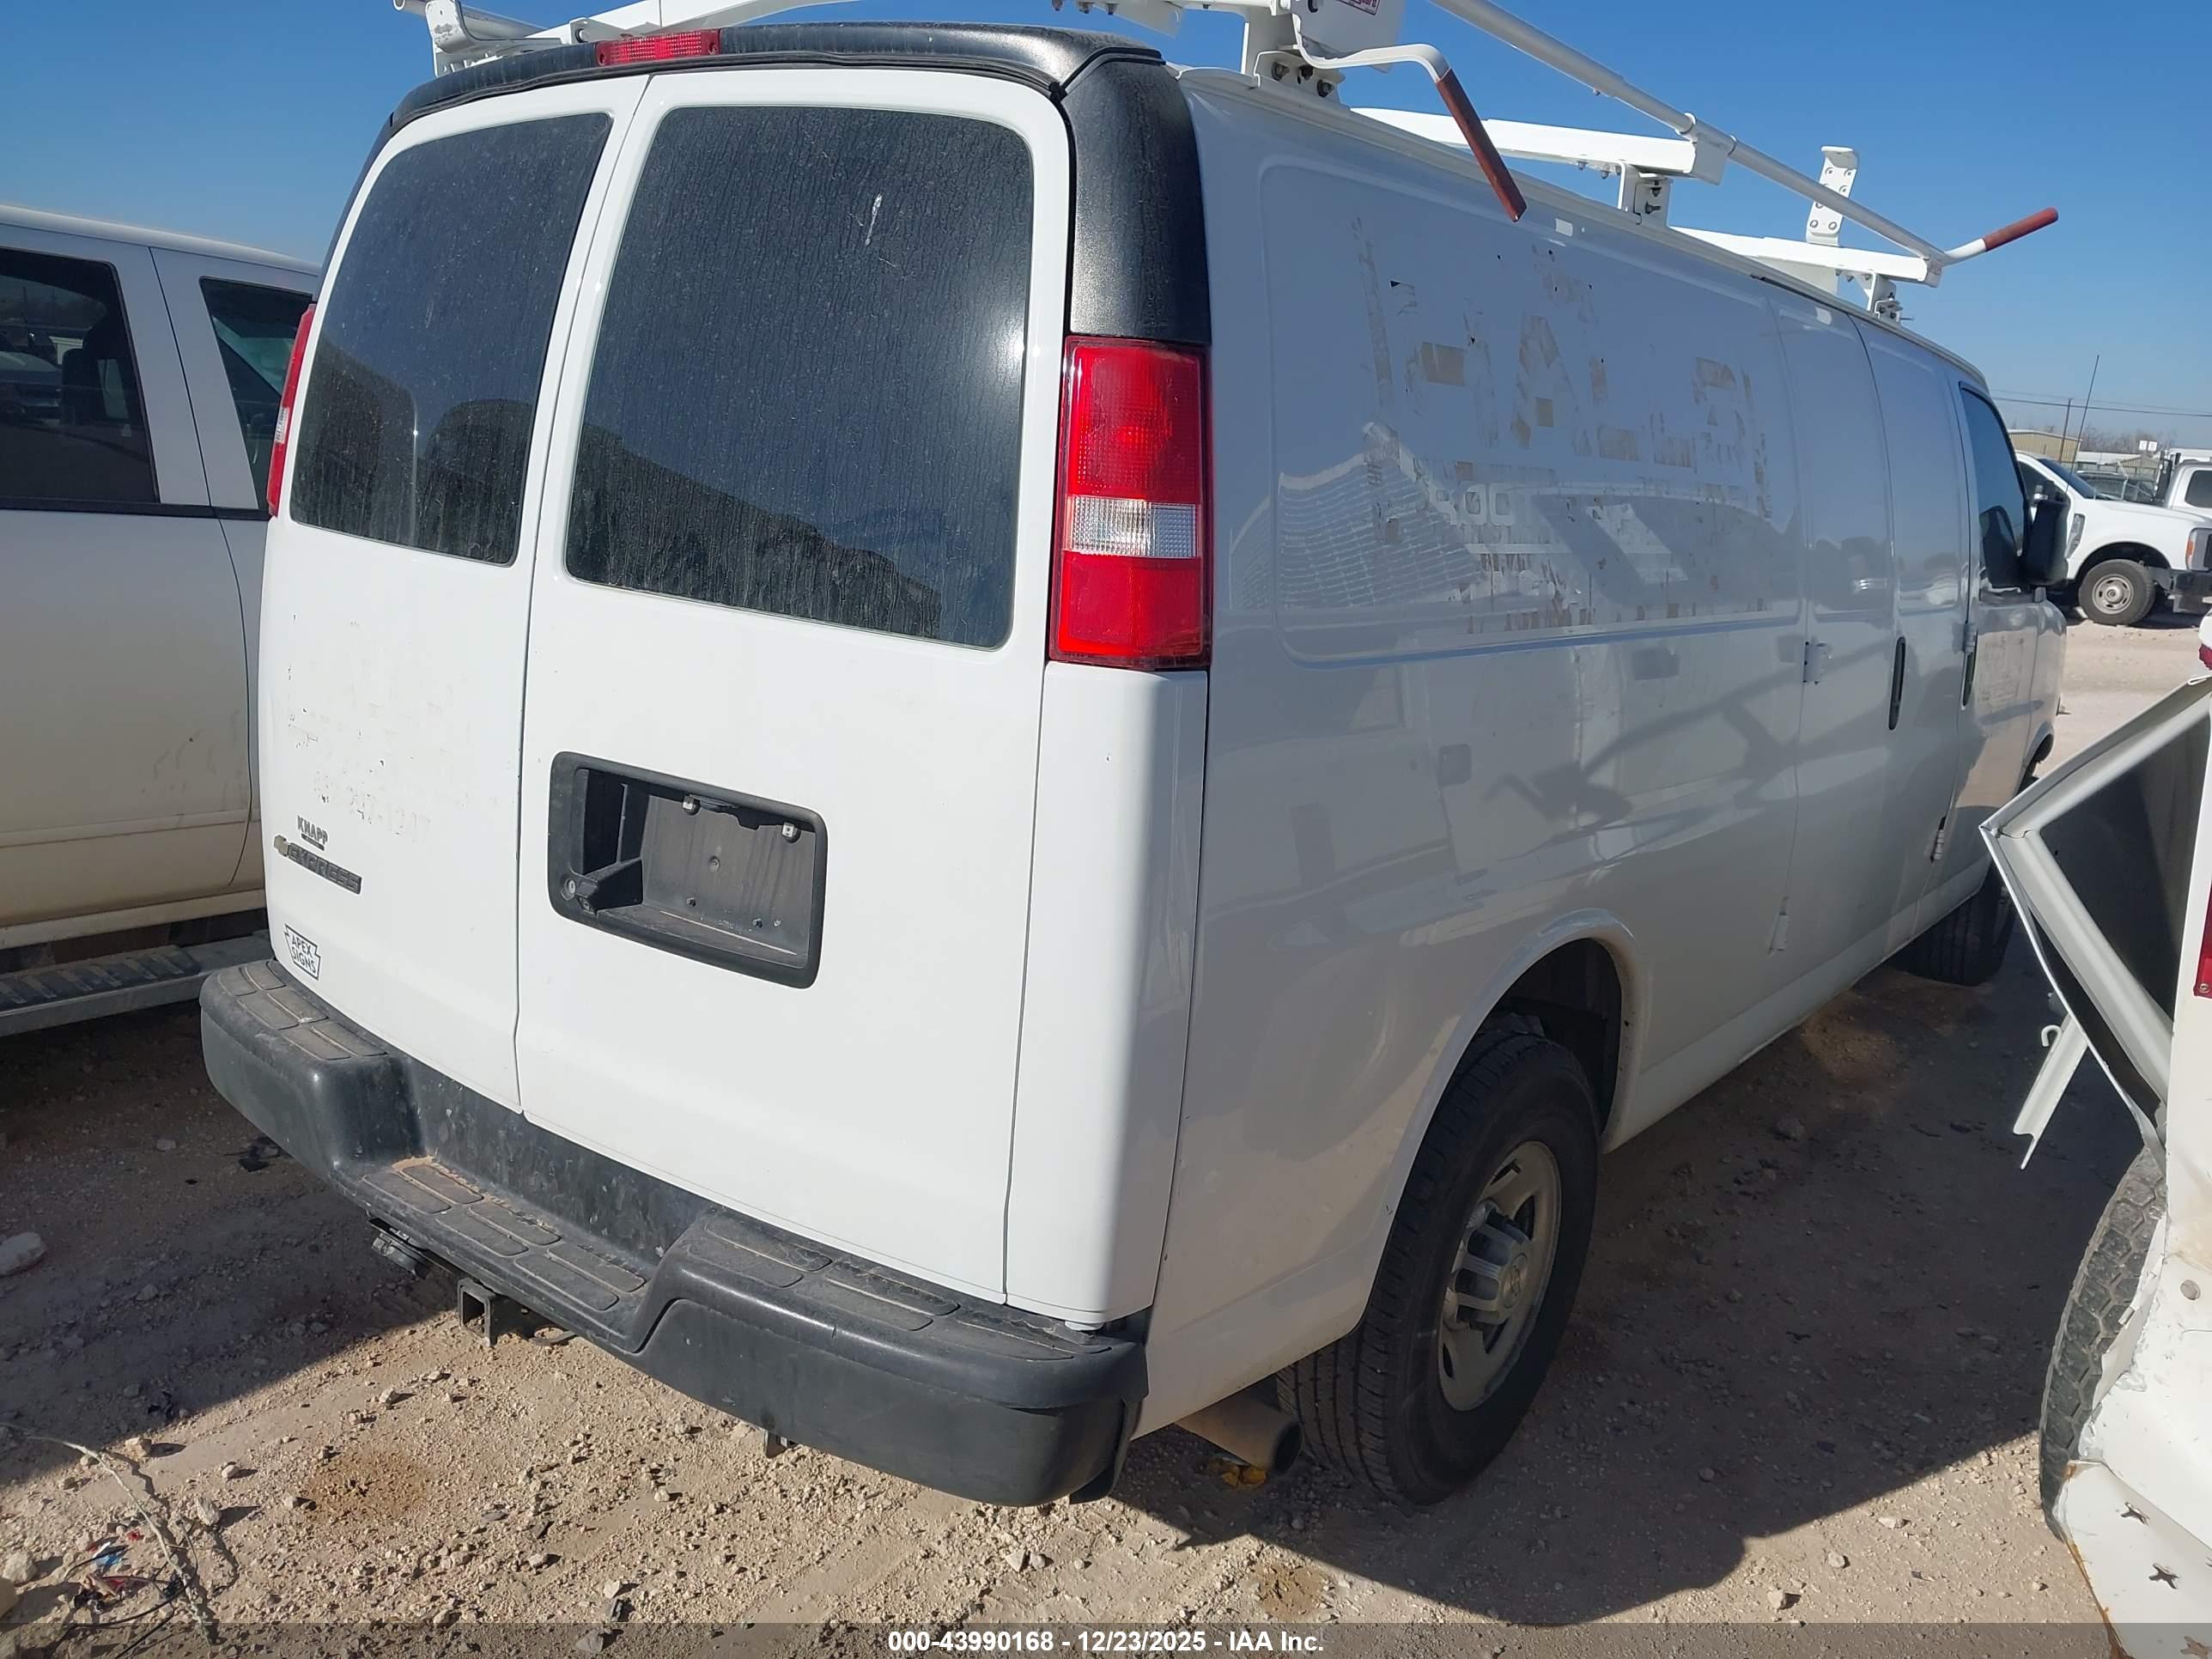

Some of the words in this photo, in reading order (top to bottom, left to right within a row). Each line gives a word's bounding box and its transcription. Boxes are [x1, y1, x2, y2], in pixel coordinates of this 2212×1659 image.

[297, 815, 328, 845] KNAPP
[289, 843, 360, 892] EXPRESS
[292, 933, 313, 958] APEX
[292, 946, 316, 973] SIGNS
